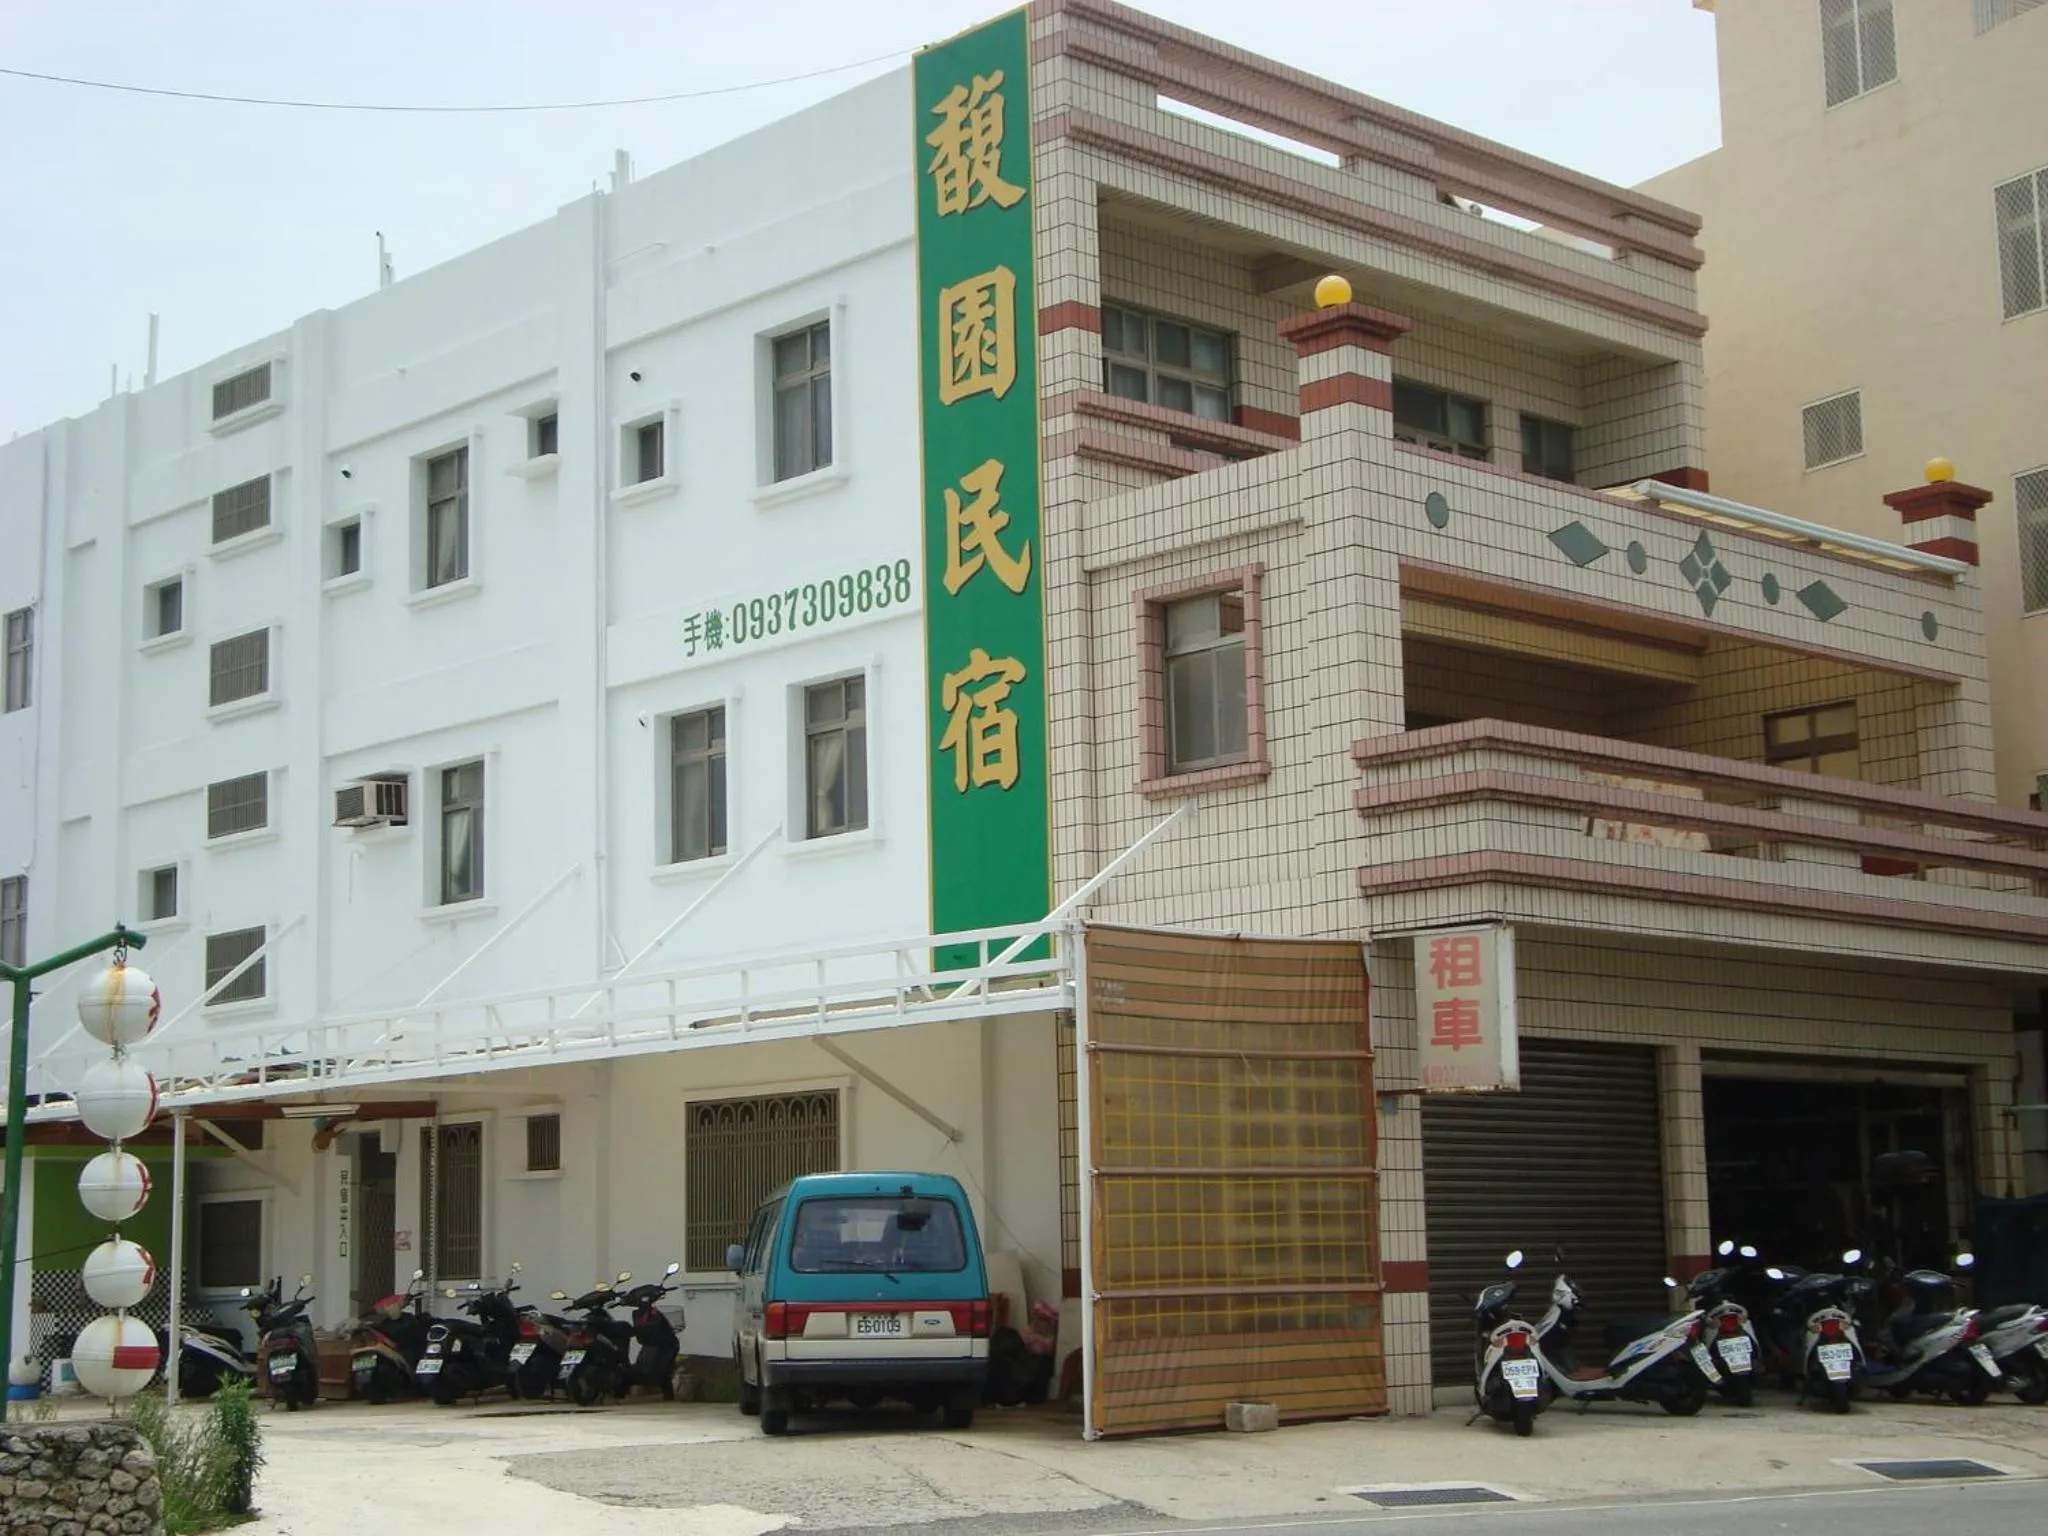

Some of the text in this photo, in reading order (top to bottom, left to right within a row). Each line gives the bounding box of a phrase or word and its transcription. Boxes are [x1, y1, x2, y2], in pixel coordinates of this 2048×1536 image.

[927, 69, 1032, 794] 馥園民宿
[1428, 936, 1484, 1052] 租車
